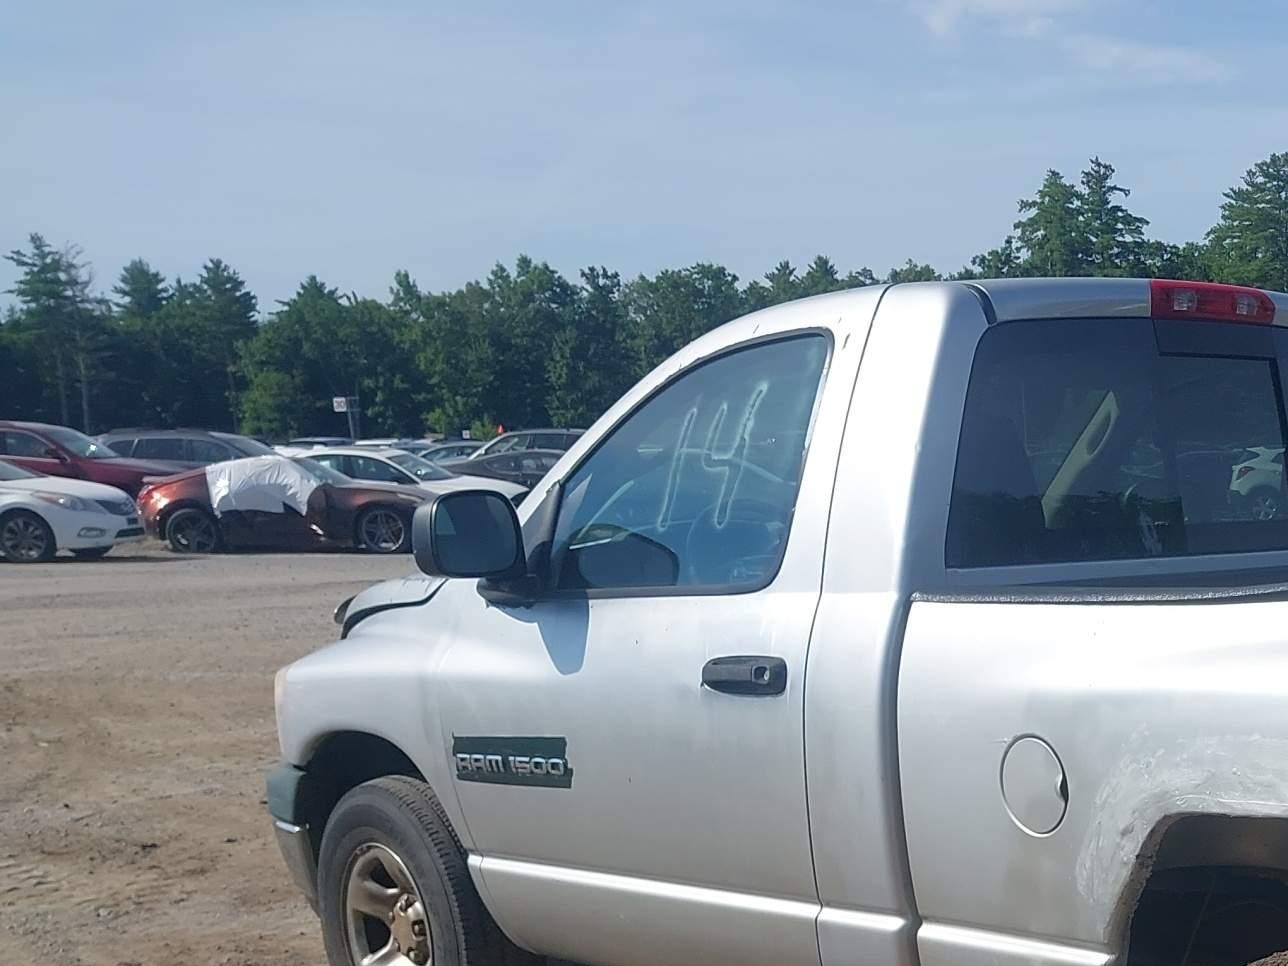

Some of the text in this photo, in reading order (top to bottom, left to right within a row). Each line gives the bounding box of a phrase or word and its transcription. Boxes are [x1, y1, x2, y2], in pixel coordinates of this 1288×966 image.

[656, 380, 771, 532] 14
[456, 753, 566, 777] RAM 1500
